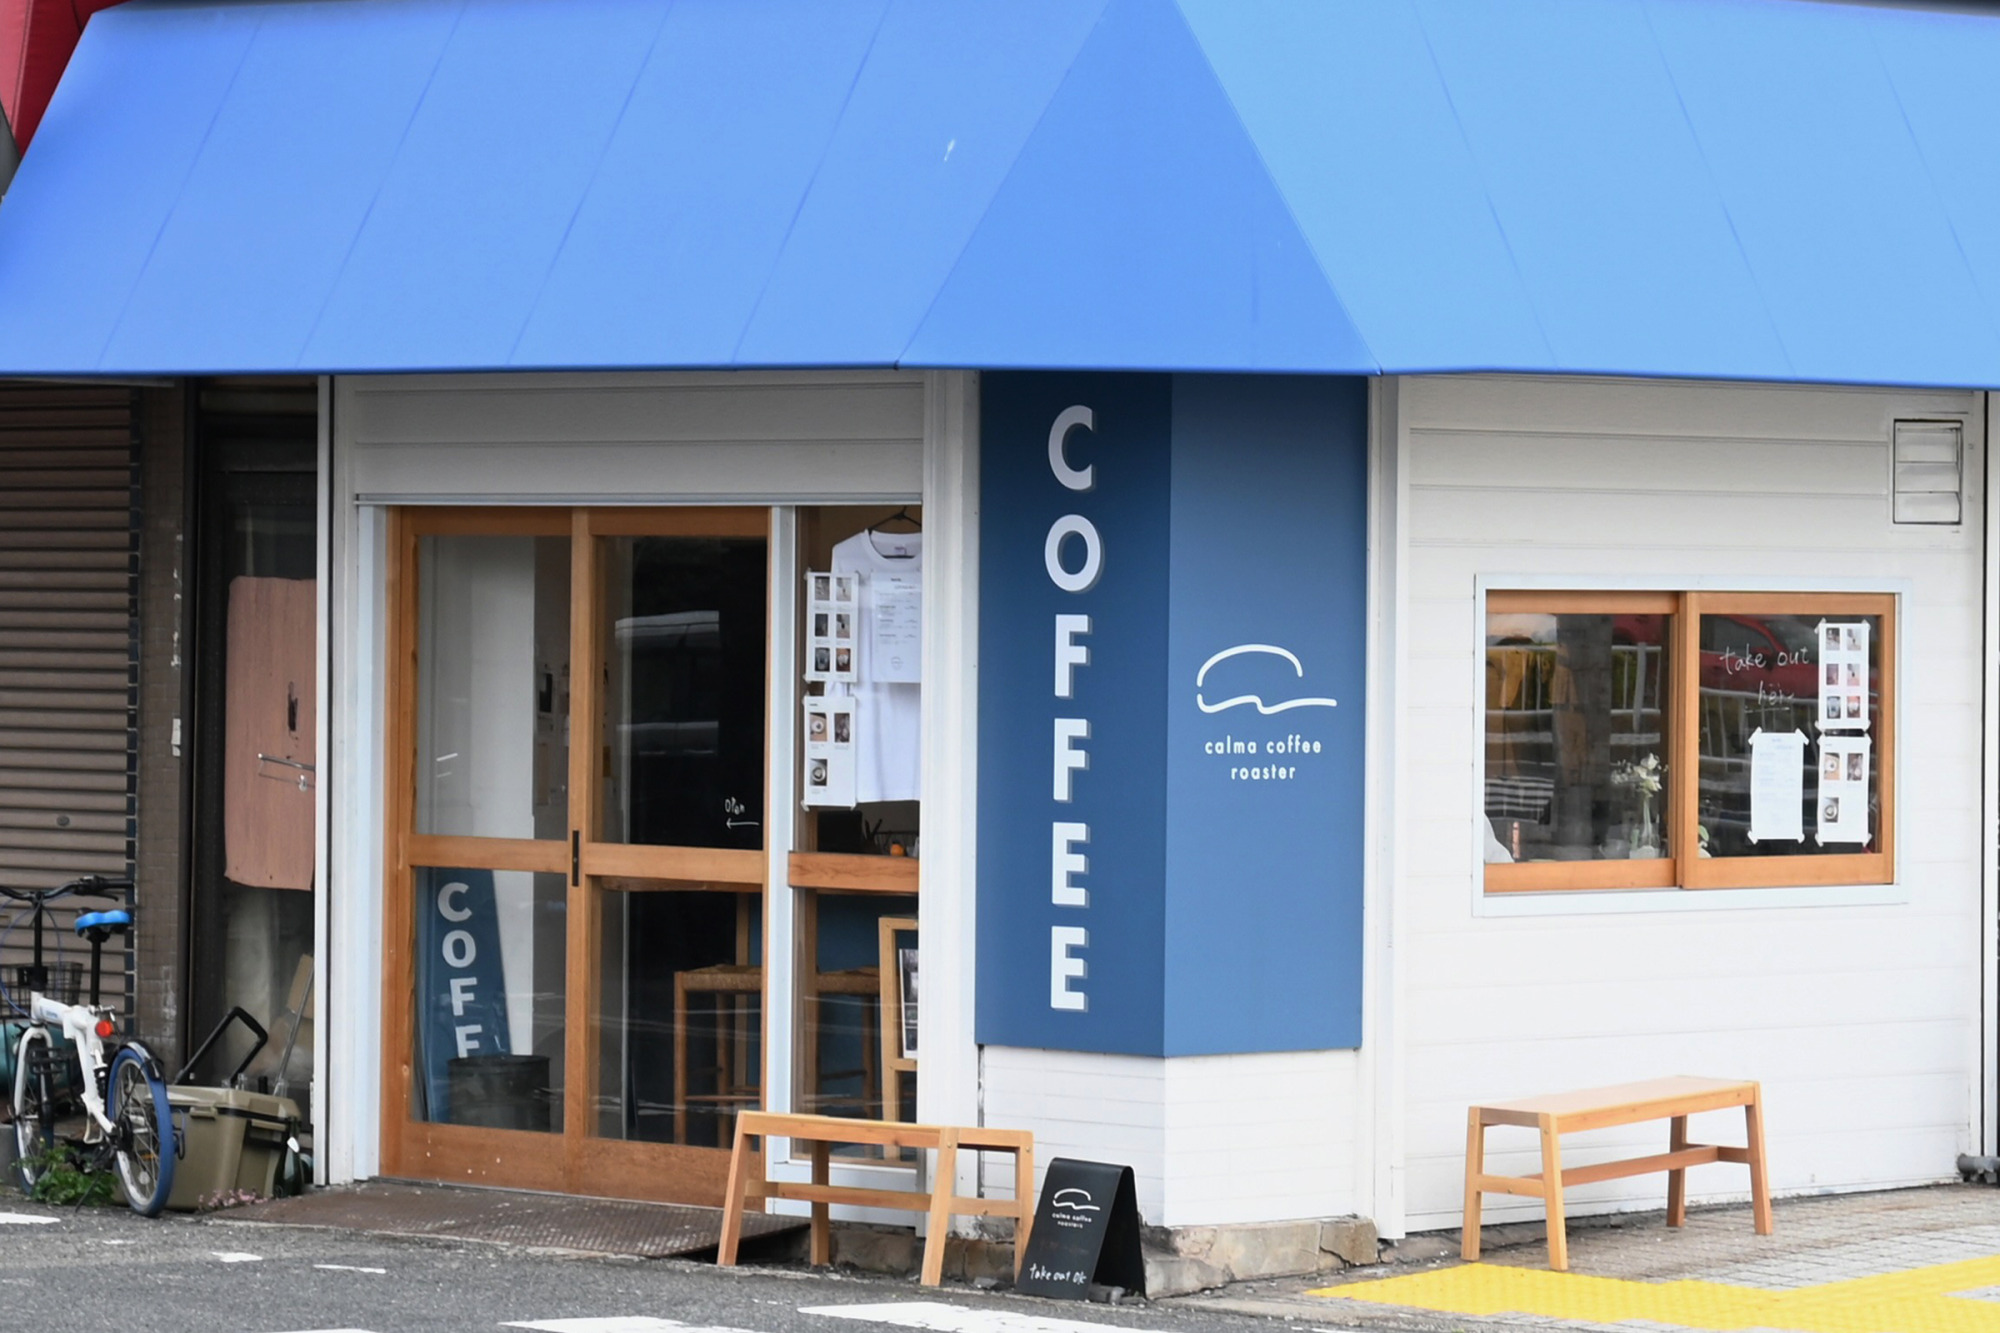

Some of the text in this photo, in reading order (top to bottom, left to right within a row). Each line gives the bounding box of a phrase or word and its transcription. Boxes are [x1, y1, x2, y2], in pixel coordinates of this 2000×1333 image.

[1719, 643, 1810, 675] take out
[1044, 404, 1103, 1011] COFFEE
[1205, 734, 1322, 755] calma coffee
[1231, 764, 1296, 780] roaster
[1029, 1262, 1051, 1280] take
[1053, 1271, 1071, 1282] out
